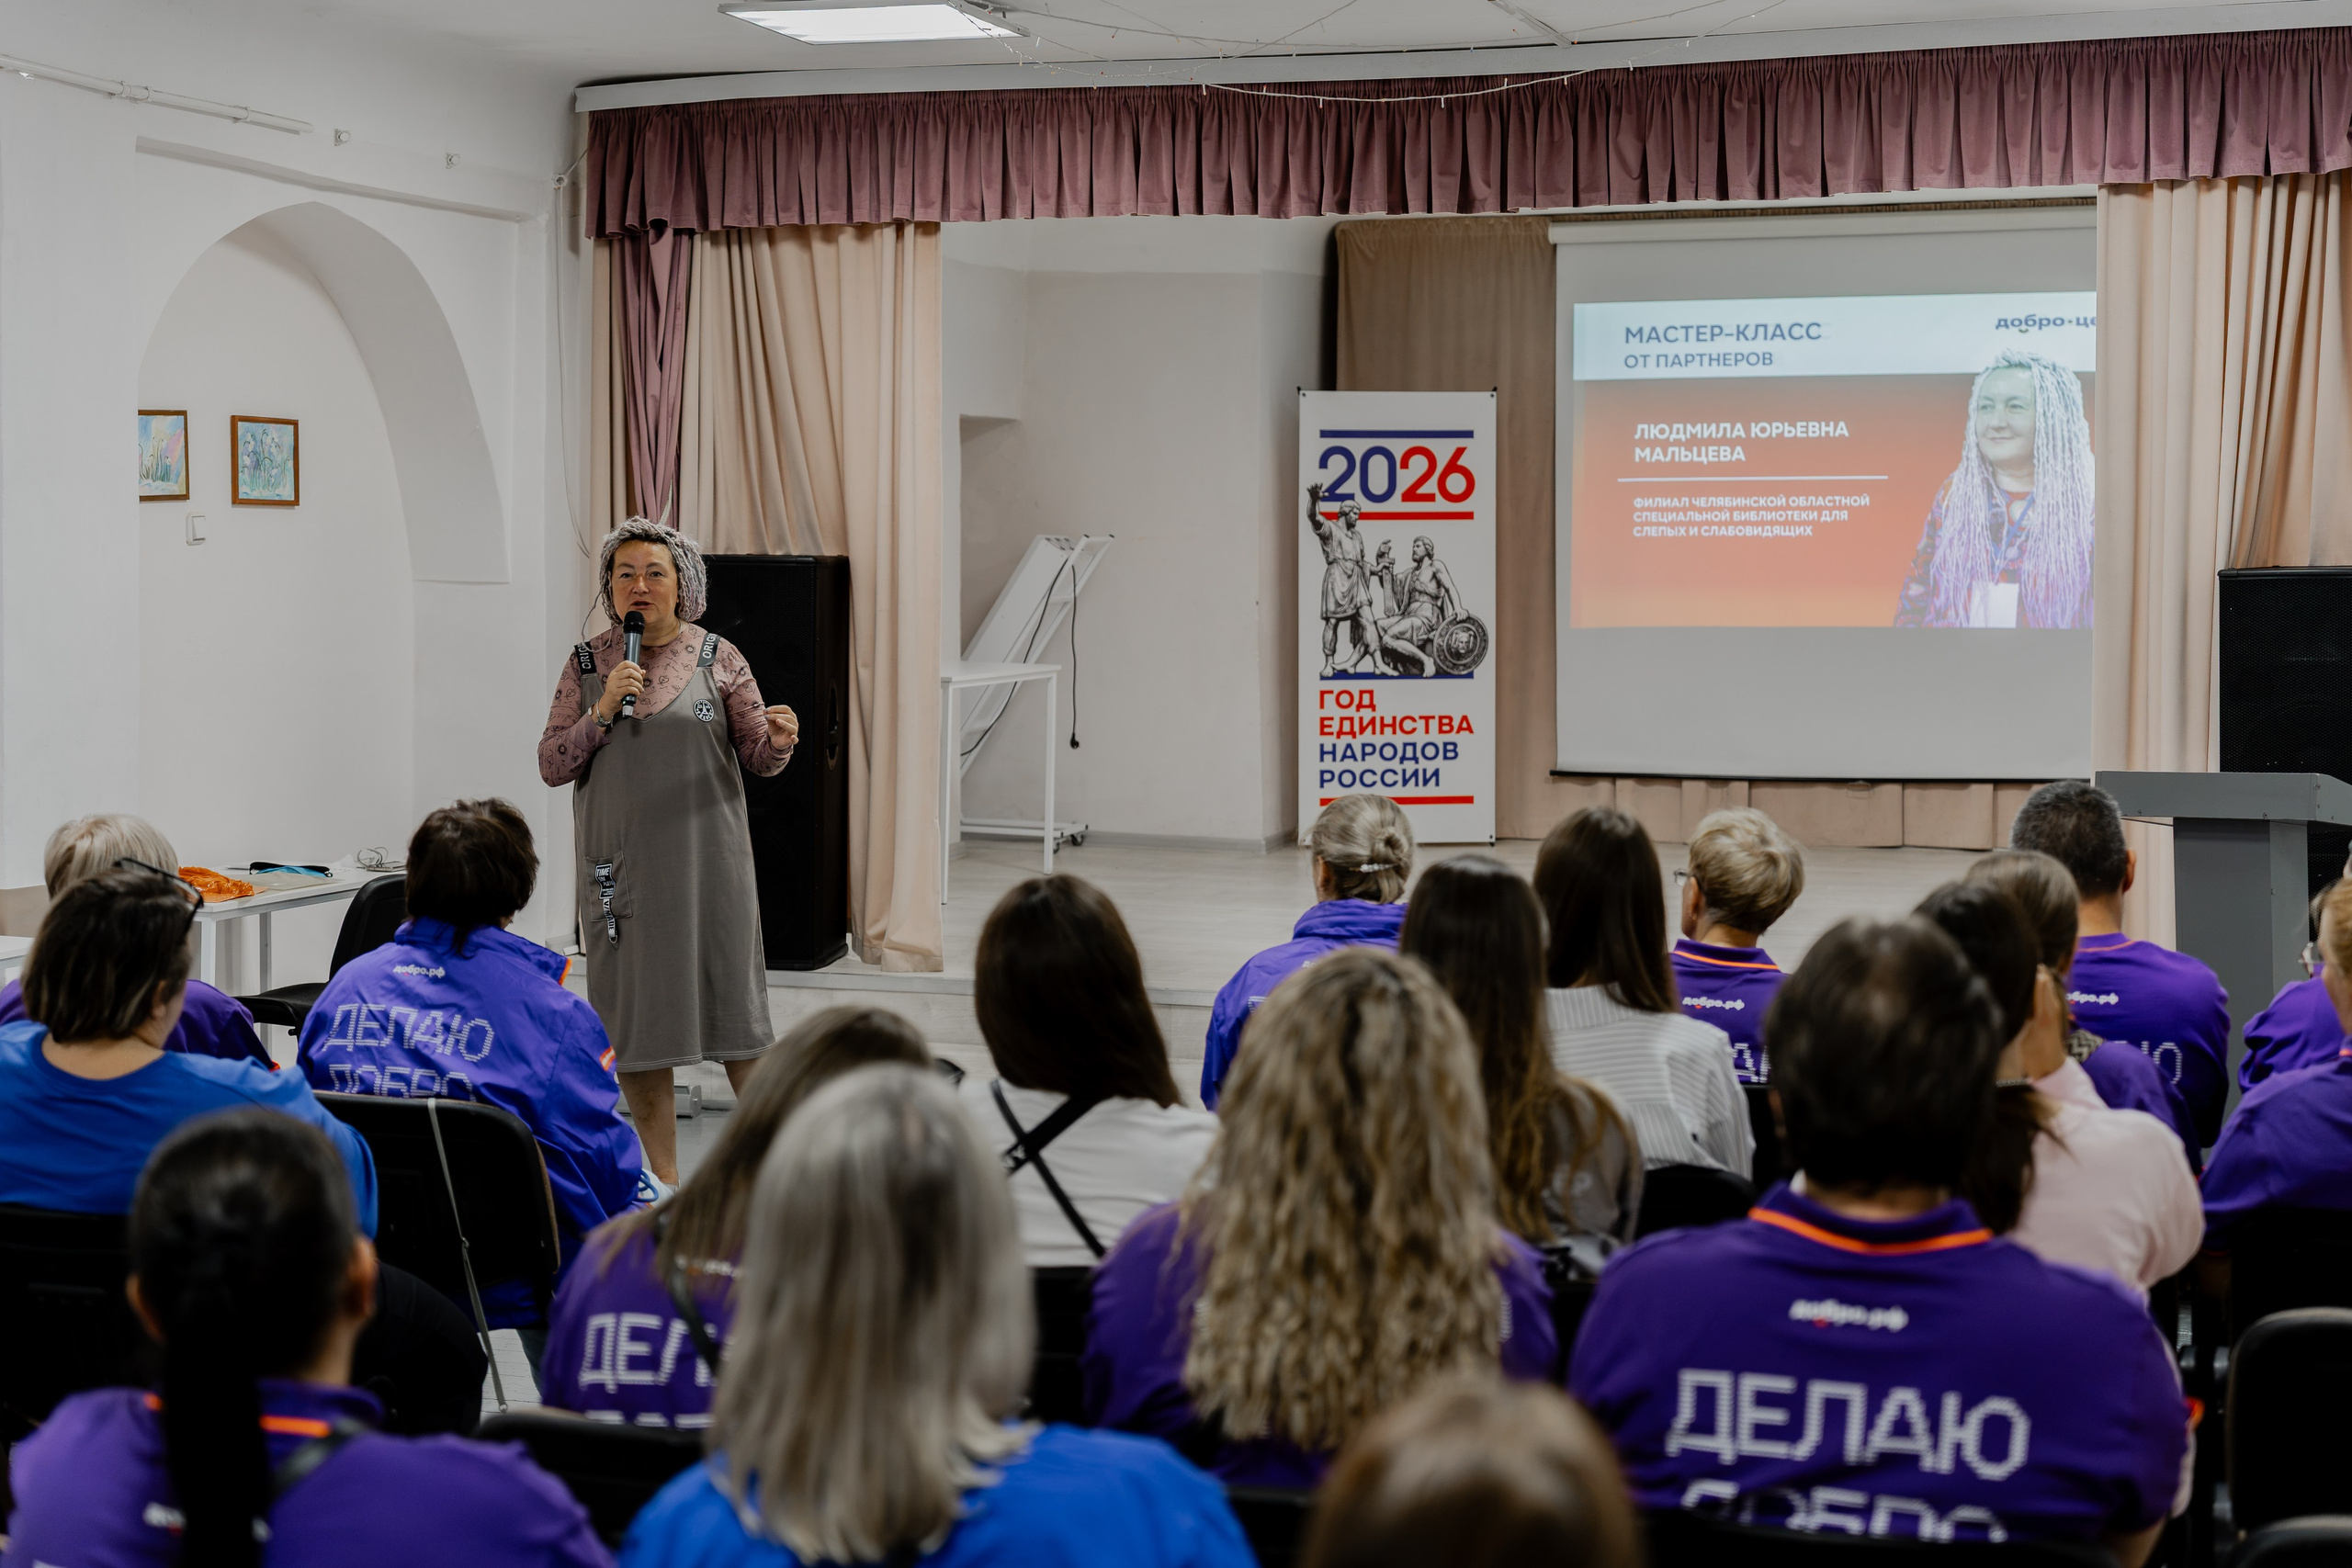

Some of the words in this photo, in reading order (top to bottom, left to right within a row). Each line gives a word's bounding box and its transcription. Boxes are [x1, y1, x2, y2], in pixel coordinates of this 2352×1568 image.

[1624, 322, 1823, 344] МАСТЕР-КЛАСС
[1623, 354, 1651, 369] ОТ
[1656, 352, 1774, 368] ПАРТНЕРОВ
[1634, 422, 1747, 443] ЛЮДМИЛА
[1749, 420, 1849, 439] ЮРЬЕВНА
[1634, 446, 1747, 466] МАЛЬЦЕВА
[1318, 445, 1476, 503] 2026
[1633, 497, 1690, 509] ФИЛИАЛ
[1691, 494, 1787, 509] ЧЕЛЯБИНСКОЙ
[1788, 492, 1871, 507] ОБЛАСТНОЙ
[1633, 509, 1731, 524] СПЕЦИАЛЬНОЙ
[1732, 510, 1819, 523] БИБЛИОТЕКИ
[1820, 510, 1849, 524] ДЛЯ
[1633, 525, 1687, 537] СЛЕПЫХ
[1688, 525, 1699, 536] И
[1700, 525, 1814, 538] СЛАБОВИДЯЩИХ
[1318, 689, 1377, 713] ГОД
[1318, 715, 1475, 739] ЕДИНСТВА
[1318, 741, 1460, 765] НАРОДОВ
[1318, 768, 1441, 789] РОССИИ
[392, 964, 447, 979] добро.рф
[2065, 990, 2120, 1006] обро.рф
[322, 1002, 495, 1063] ДЕЛАЮ
[1664, 1367, 2032, 1482] ДЕЛАЮ
